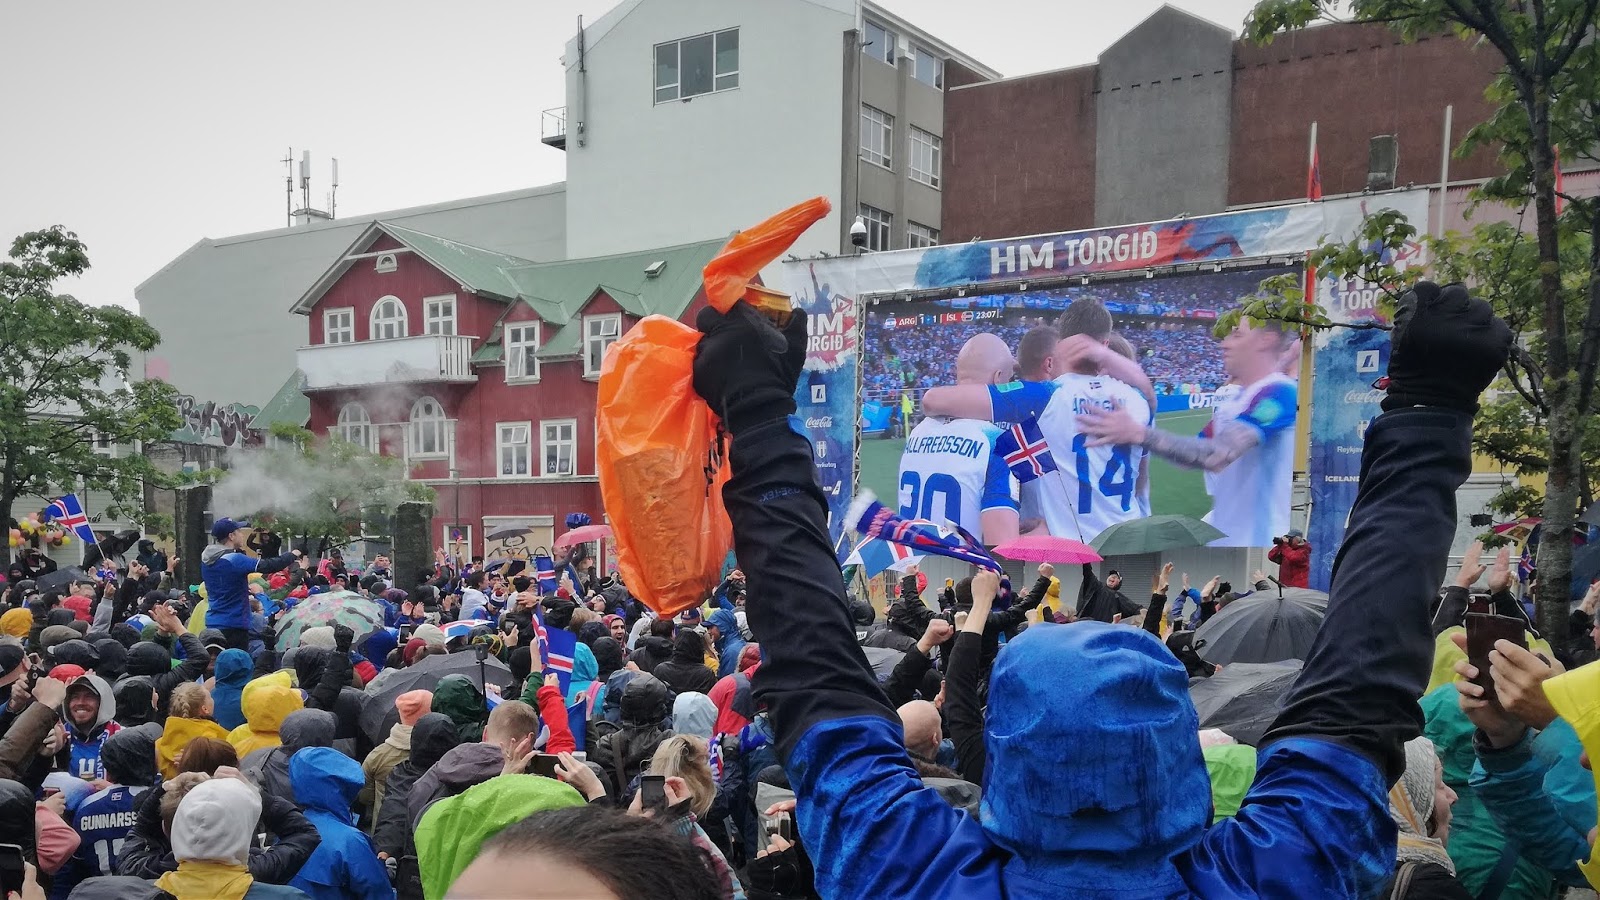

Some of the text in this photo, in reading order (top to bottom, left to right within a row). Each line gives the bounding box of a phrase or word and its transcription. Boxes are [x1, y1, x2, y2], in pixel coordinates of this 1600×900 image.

[990, 230, 1158, 274] HM TORGIÐ
[807, 312, 843, 336] M
[898, 317, 916, 326] ARG
[920, 315, 925, 324] 1
[933, 315, 937, 323] 1
[975, 310, 996, 319] 23:07
[1072, 432, 1134, 515] 14
